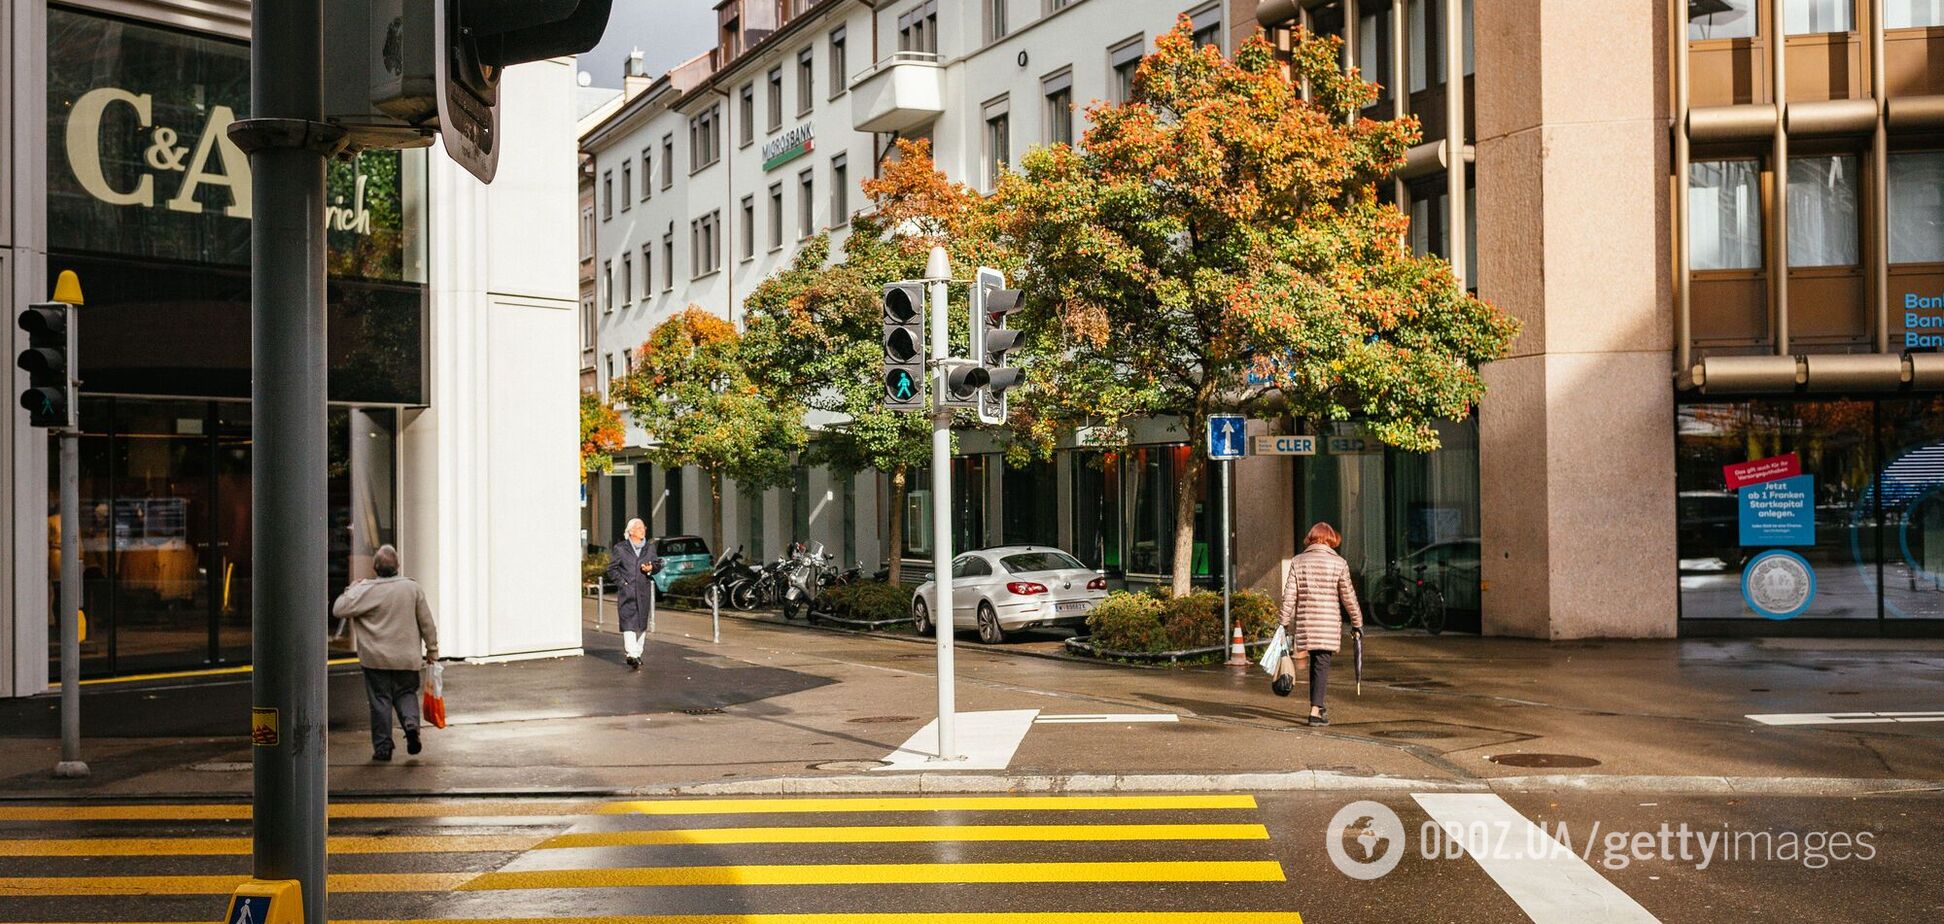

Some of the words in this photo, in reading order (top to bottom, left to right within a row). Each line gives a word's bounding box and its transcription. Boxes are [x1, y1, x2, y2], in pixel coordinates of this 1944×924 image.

[65, 86, 253, 219] C&A
[326, 174, 371, 236] rich
[1904, 293, 1944, 308] Ban
[1904, 313, 1944, 328] Ban
[1904, 332, 1944, 347] Ban
[1276, 439, 1312, 452] CLER
[1765, 482, 1787, 490] Jetzt
[1748, 491, 1760, 499] ab
[1769, 491, 1805, 499] Franken
[1750, 500, 1803, 509] Startkapital
[1758, 510, 1795, 519] anlegen.
